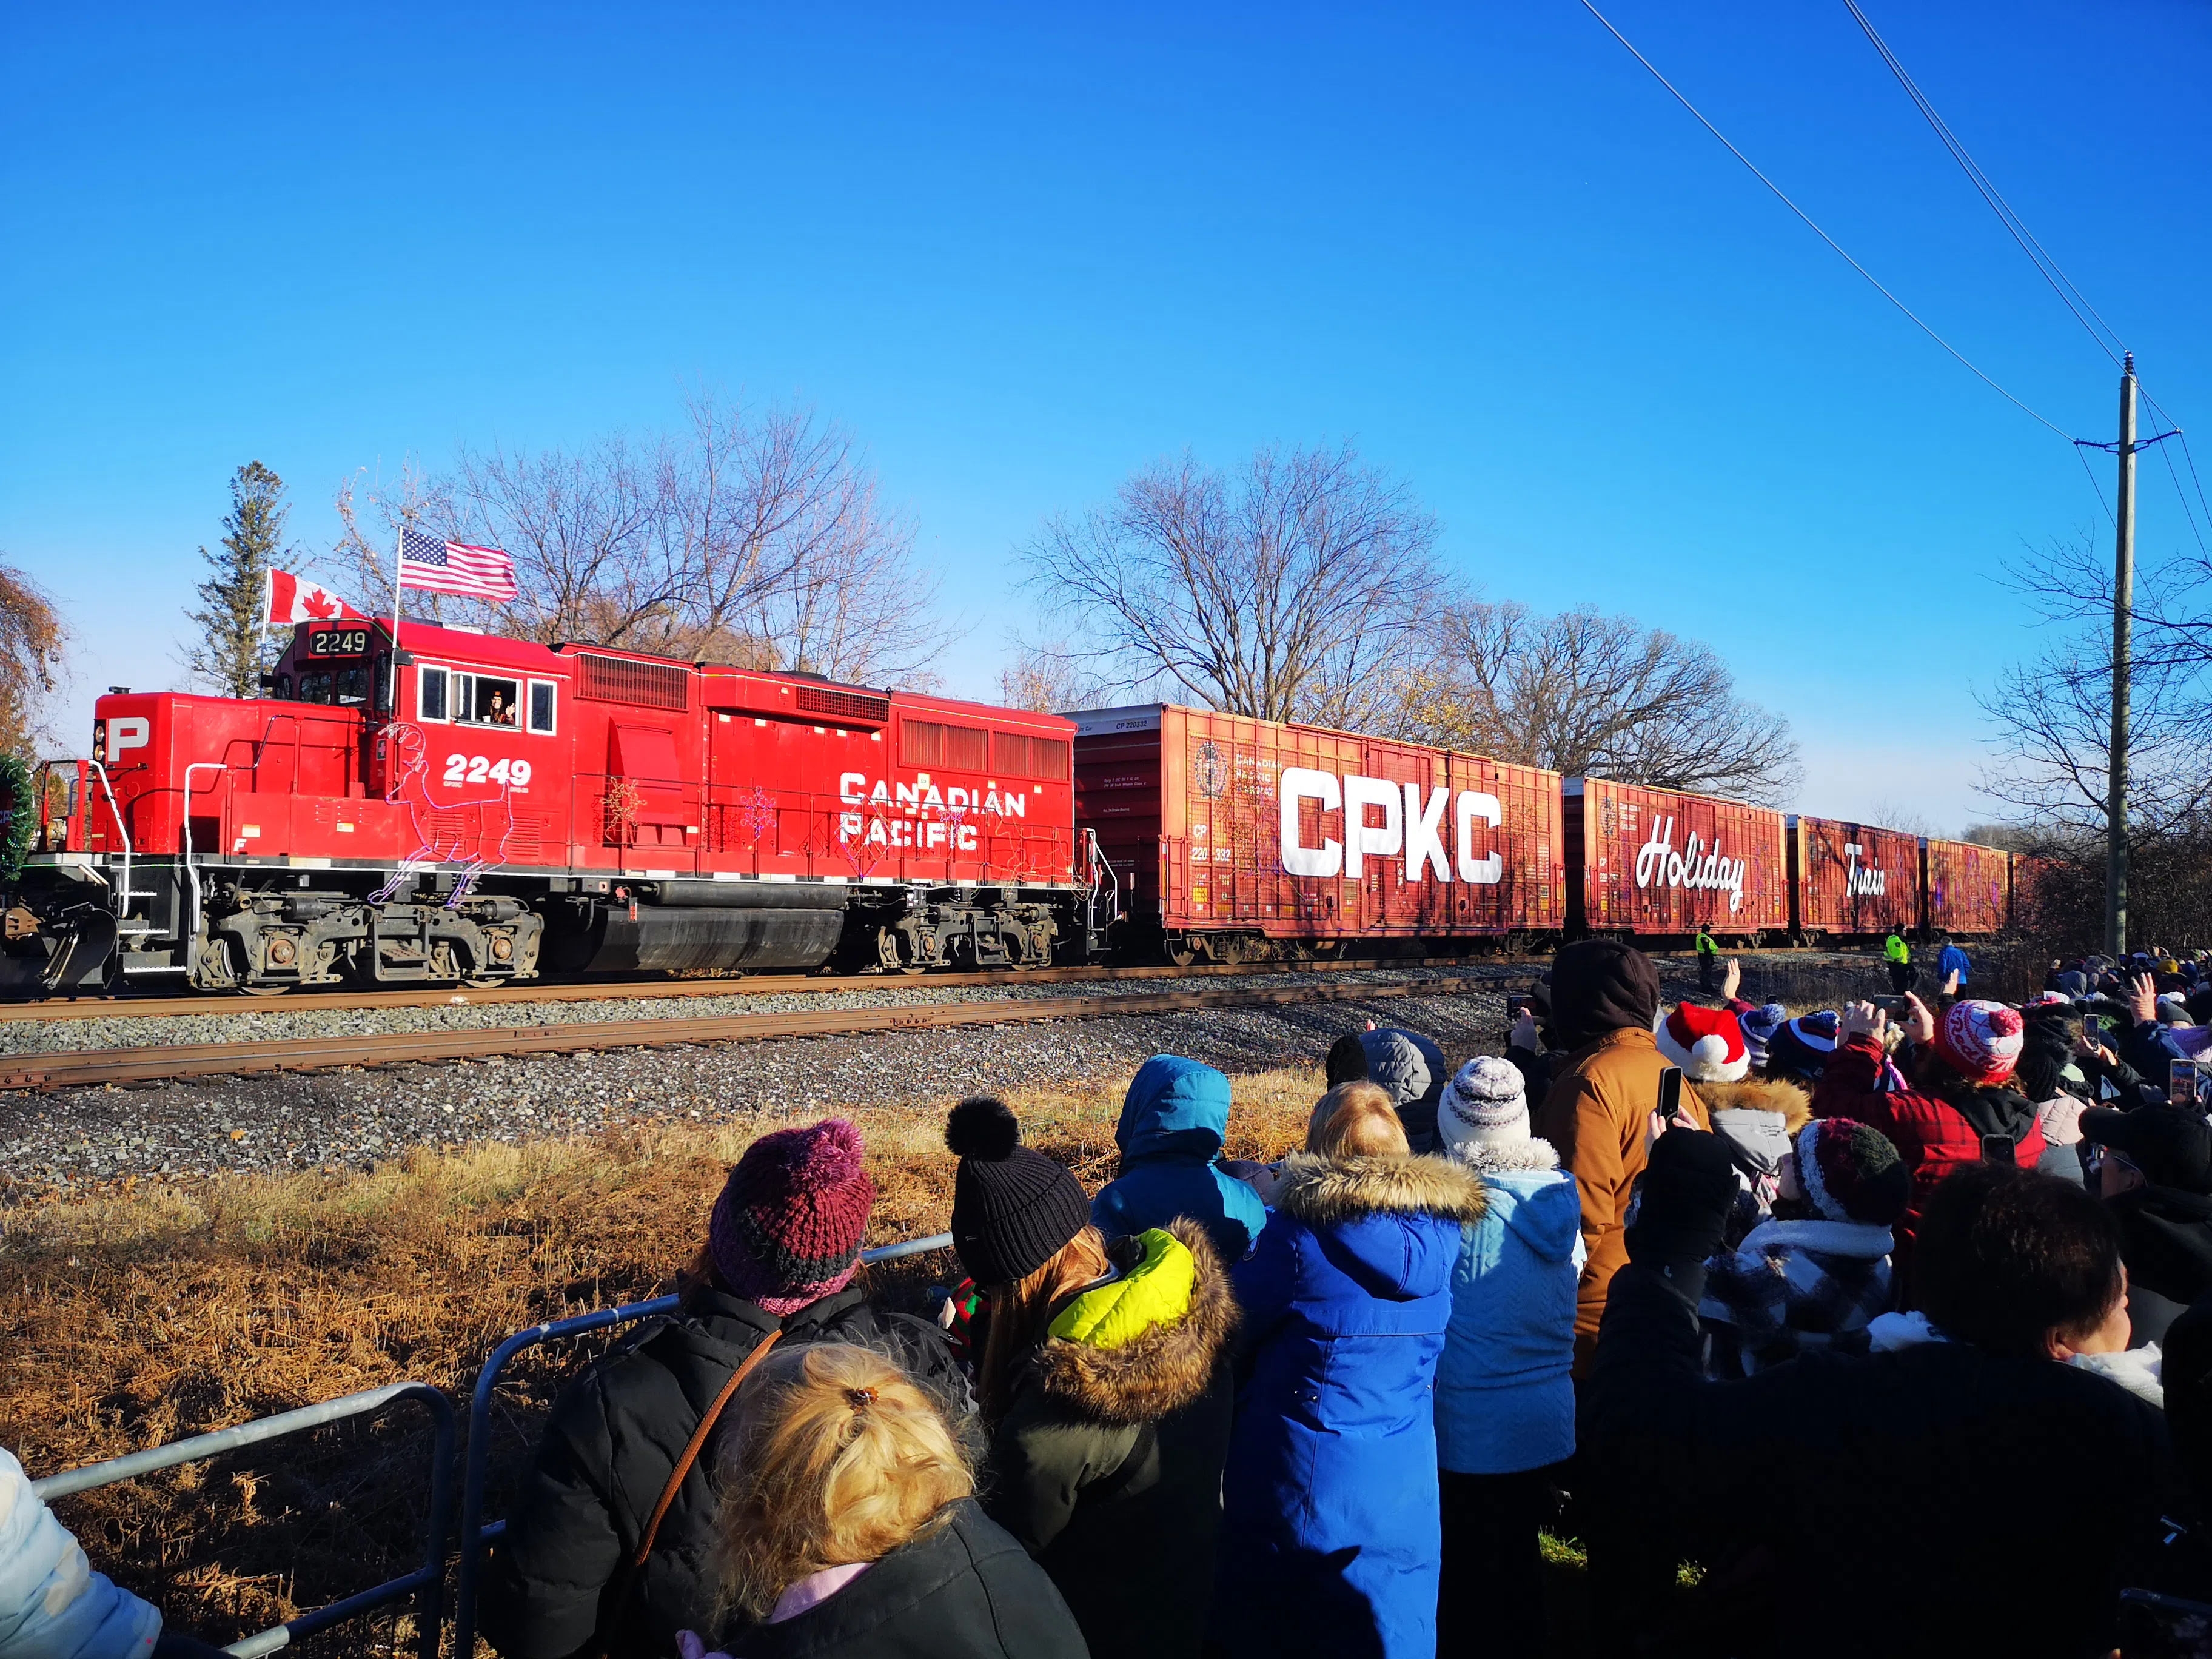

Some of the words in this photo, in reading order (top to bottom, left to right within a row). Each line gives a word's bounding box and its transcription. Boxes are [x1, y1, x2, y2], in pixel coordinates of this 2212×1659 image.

[316, 632, 365, 652] 2249
[108, 717, 149, 762] P
[443, 753, 532, 786] 2249
[840, 772, 1025, 817] CANADIAN
[233, 838, 247, 851] F
[840, 811, 977, 850] PACIFIC
[1193, 824, 1207, 837] CP
[1280, 767, 1503, 884] CPKC
[1191, 846, 1208, 860] 220
[1215, 848, 1231, 862] 332
[1635, 814, 1745, 912] Holiday
[1844, 843, 1885, 897] Train
